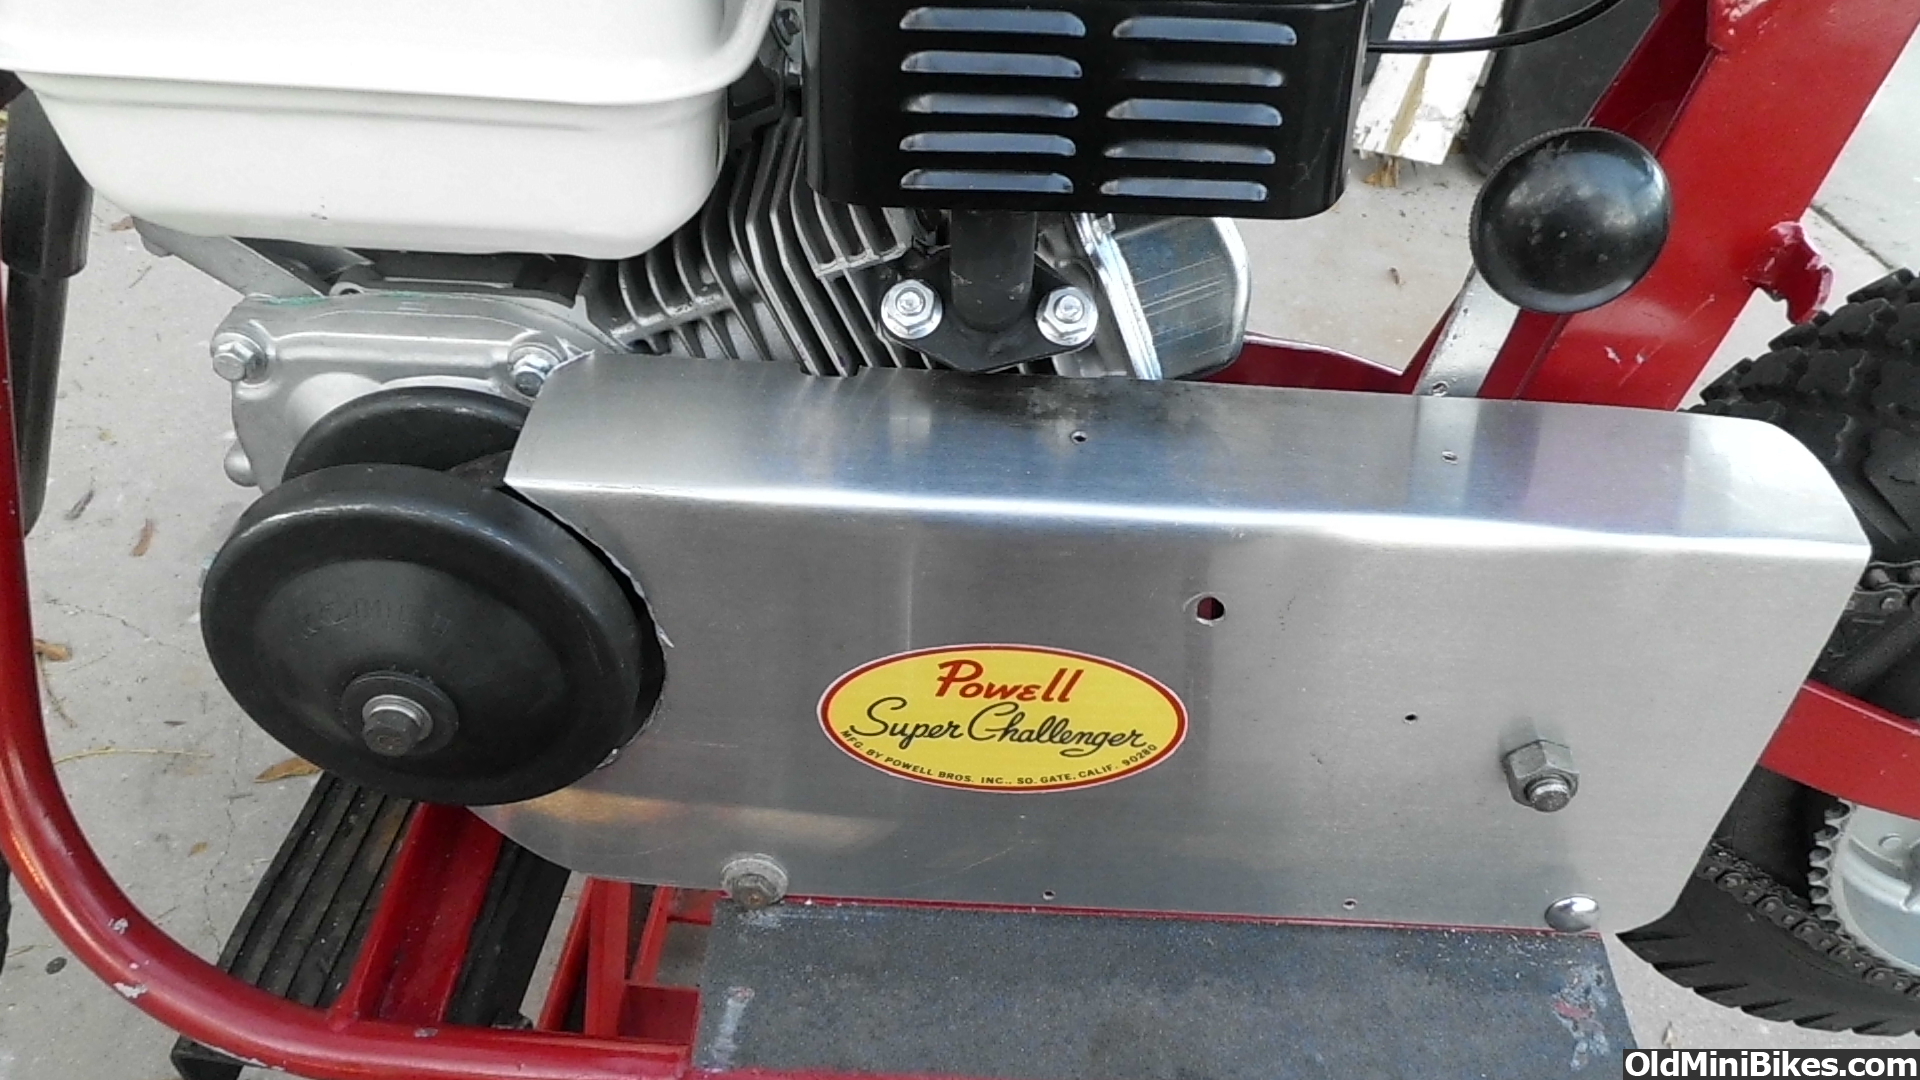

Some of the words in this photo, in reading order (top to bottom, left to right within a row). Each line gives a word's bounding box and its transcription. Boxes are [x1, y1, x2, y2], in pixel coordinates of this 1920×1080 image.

[935, 659, 1084, 703] Powell
[849, 696, 964, 750] Super
[967, 701, 1148, 758] Challenger
[840, 730, 863, 751] MFG.
[866, 748, 884, 759] BY
[884, 756, 934, 776] POWELL
[938, 771, 974, 783] BROS.
[1016, 777, 1037, 785] SO.
[1078, 764, 1118, 779] CALIF.
[1121, 744, 1158, 766] 90280
